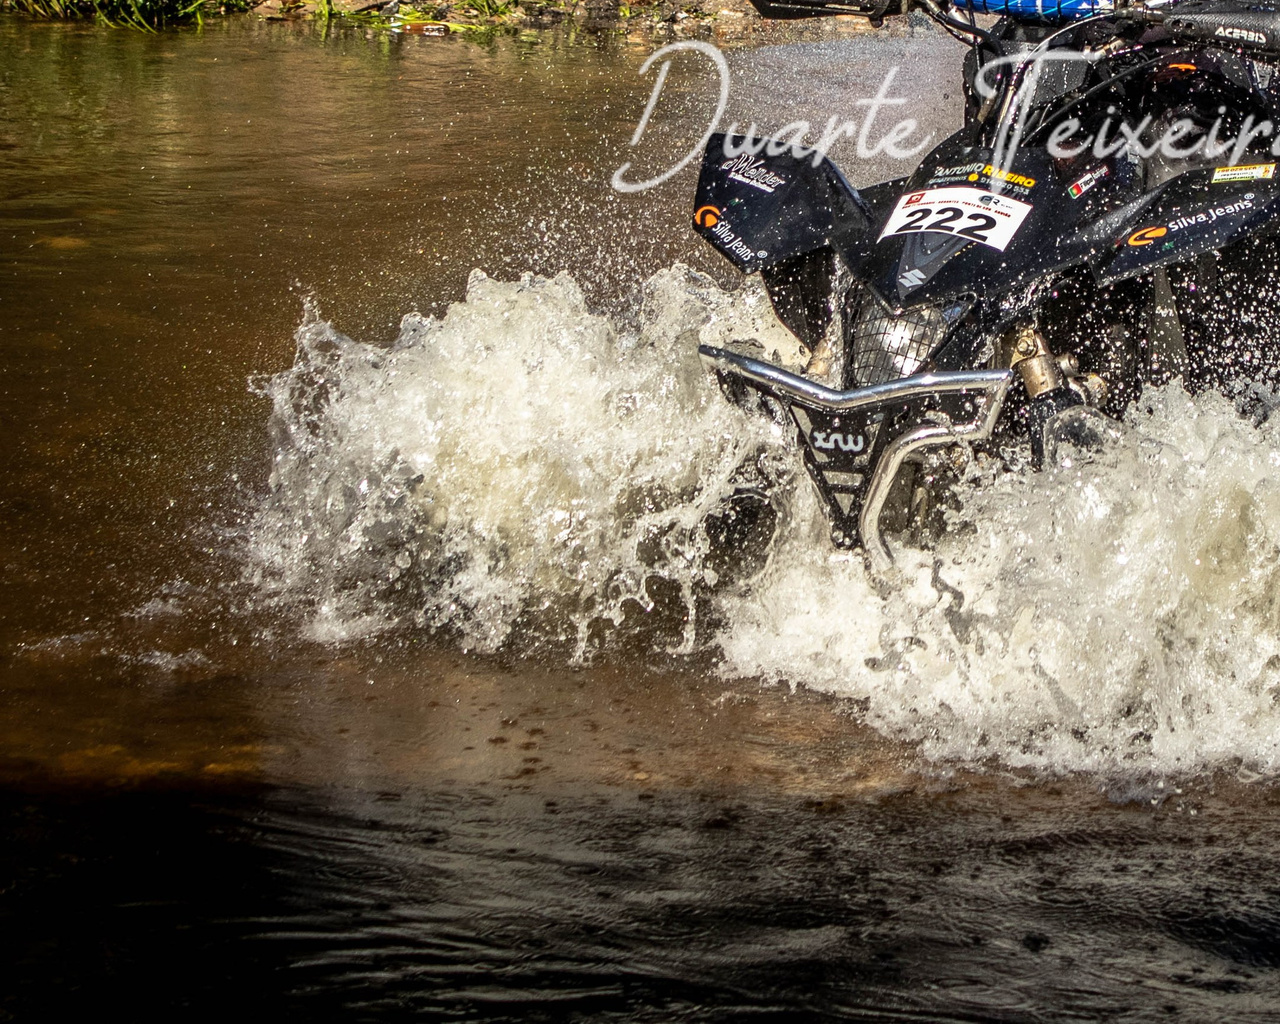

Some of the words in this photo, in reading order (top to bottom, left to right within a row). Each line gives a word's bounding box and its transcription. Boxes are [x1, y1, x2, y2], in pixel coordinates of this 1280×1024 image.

[1214, 26, 1267, 45] ACERBIS
[982, 164, 1036, 188] RIBEIRO
[894, 207, 998, 243] 222
[1168, 213, 1208, 232] Silva
[1208, 200, 1253, 221] Jeans
[711, 220, 734, 243] Silva
[724, 236, 755, 261] Jeans
